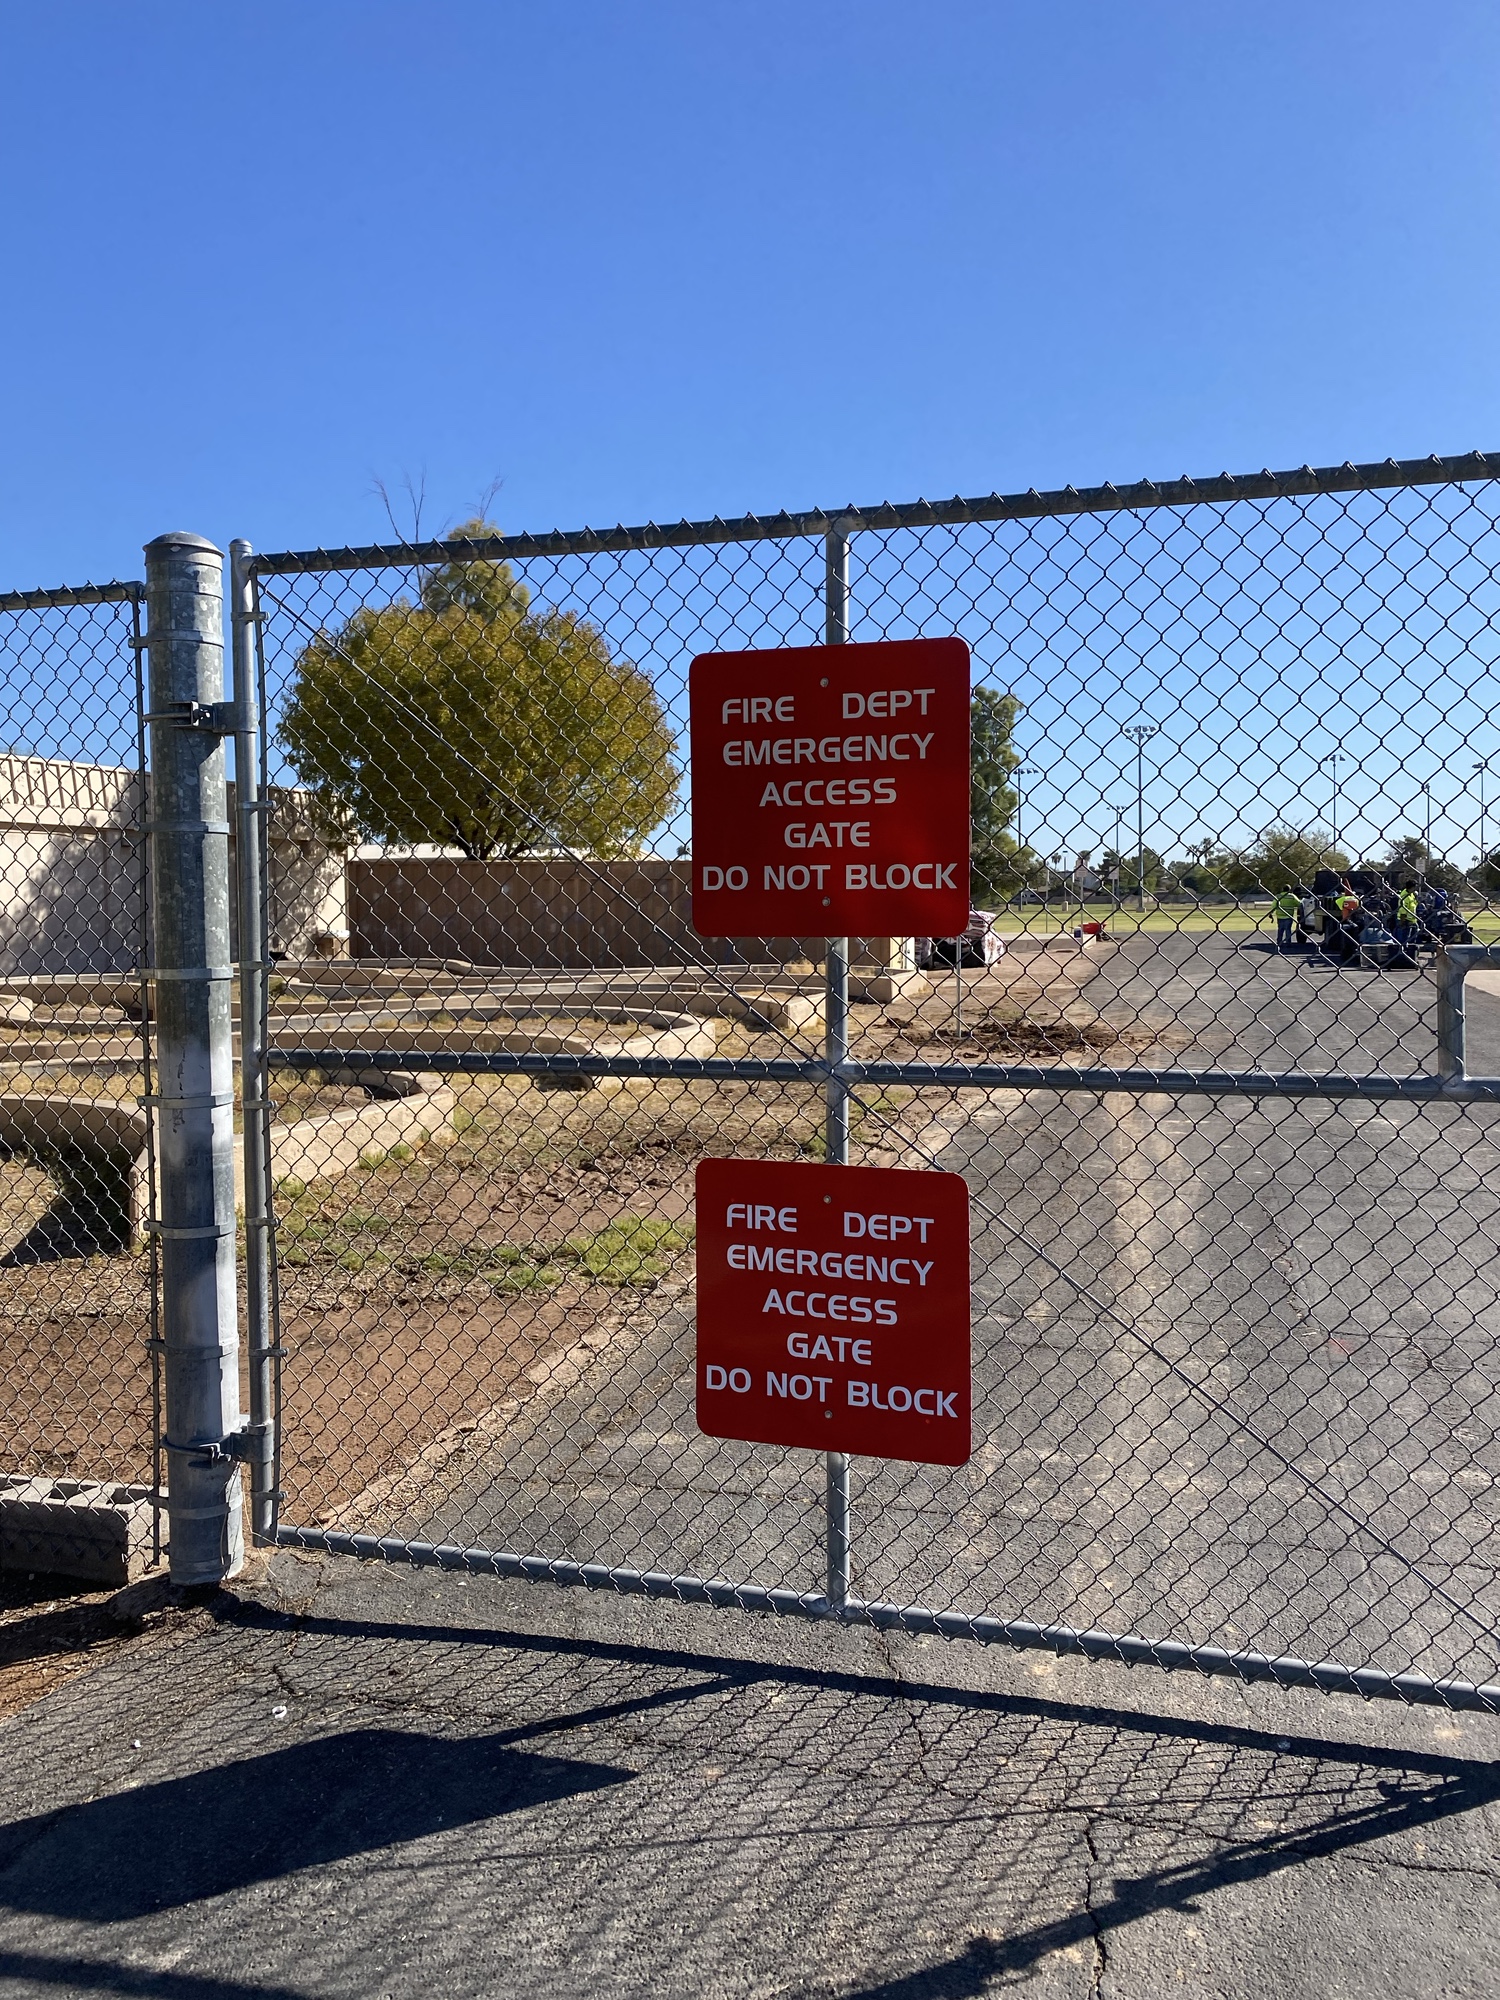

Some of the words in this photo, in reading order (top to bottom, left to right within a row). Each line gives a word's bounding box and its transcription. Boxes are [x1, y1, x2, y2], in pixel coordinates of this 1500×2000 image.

[722, 696, 795, 724] FIRE
[843, 689, 935, 719] DEPT
[723, 733, 935, 766] EMERGENCY
[759, 778, 897, 807] ACCESS
[784, 822, 870, 848] GATE
[702, 865, 748, 891] DO
[764, 865, 831, 890] NOT
[846, 863, 958, 890] BLOCK
[726, 1203, 797, 1232] FIRE
[843, 1211, 935, 1243] DEPT
[727, 1244, 935, 1286] EMERGENCY
[762, 1288, 898, 1325] ACCESS
[787, 1332, 872, 1365] GATE
[706, 1365, 751, 1393] DO
[766, 1371, 833, 1402] NOT
[847, 1380, 958, 1418] BLOCK
